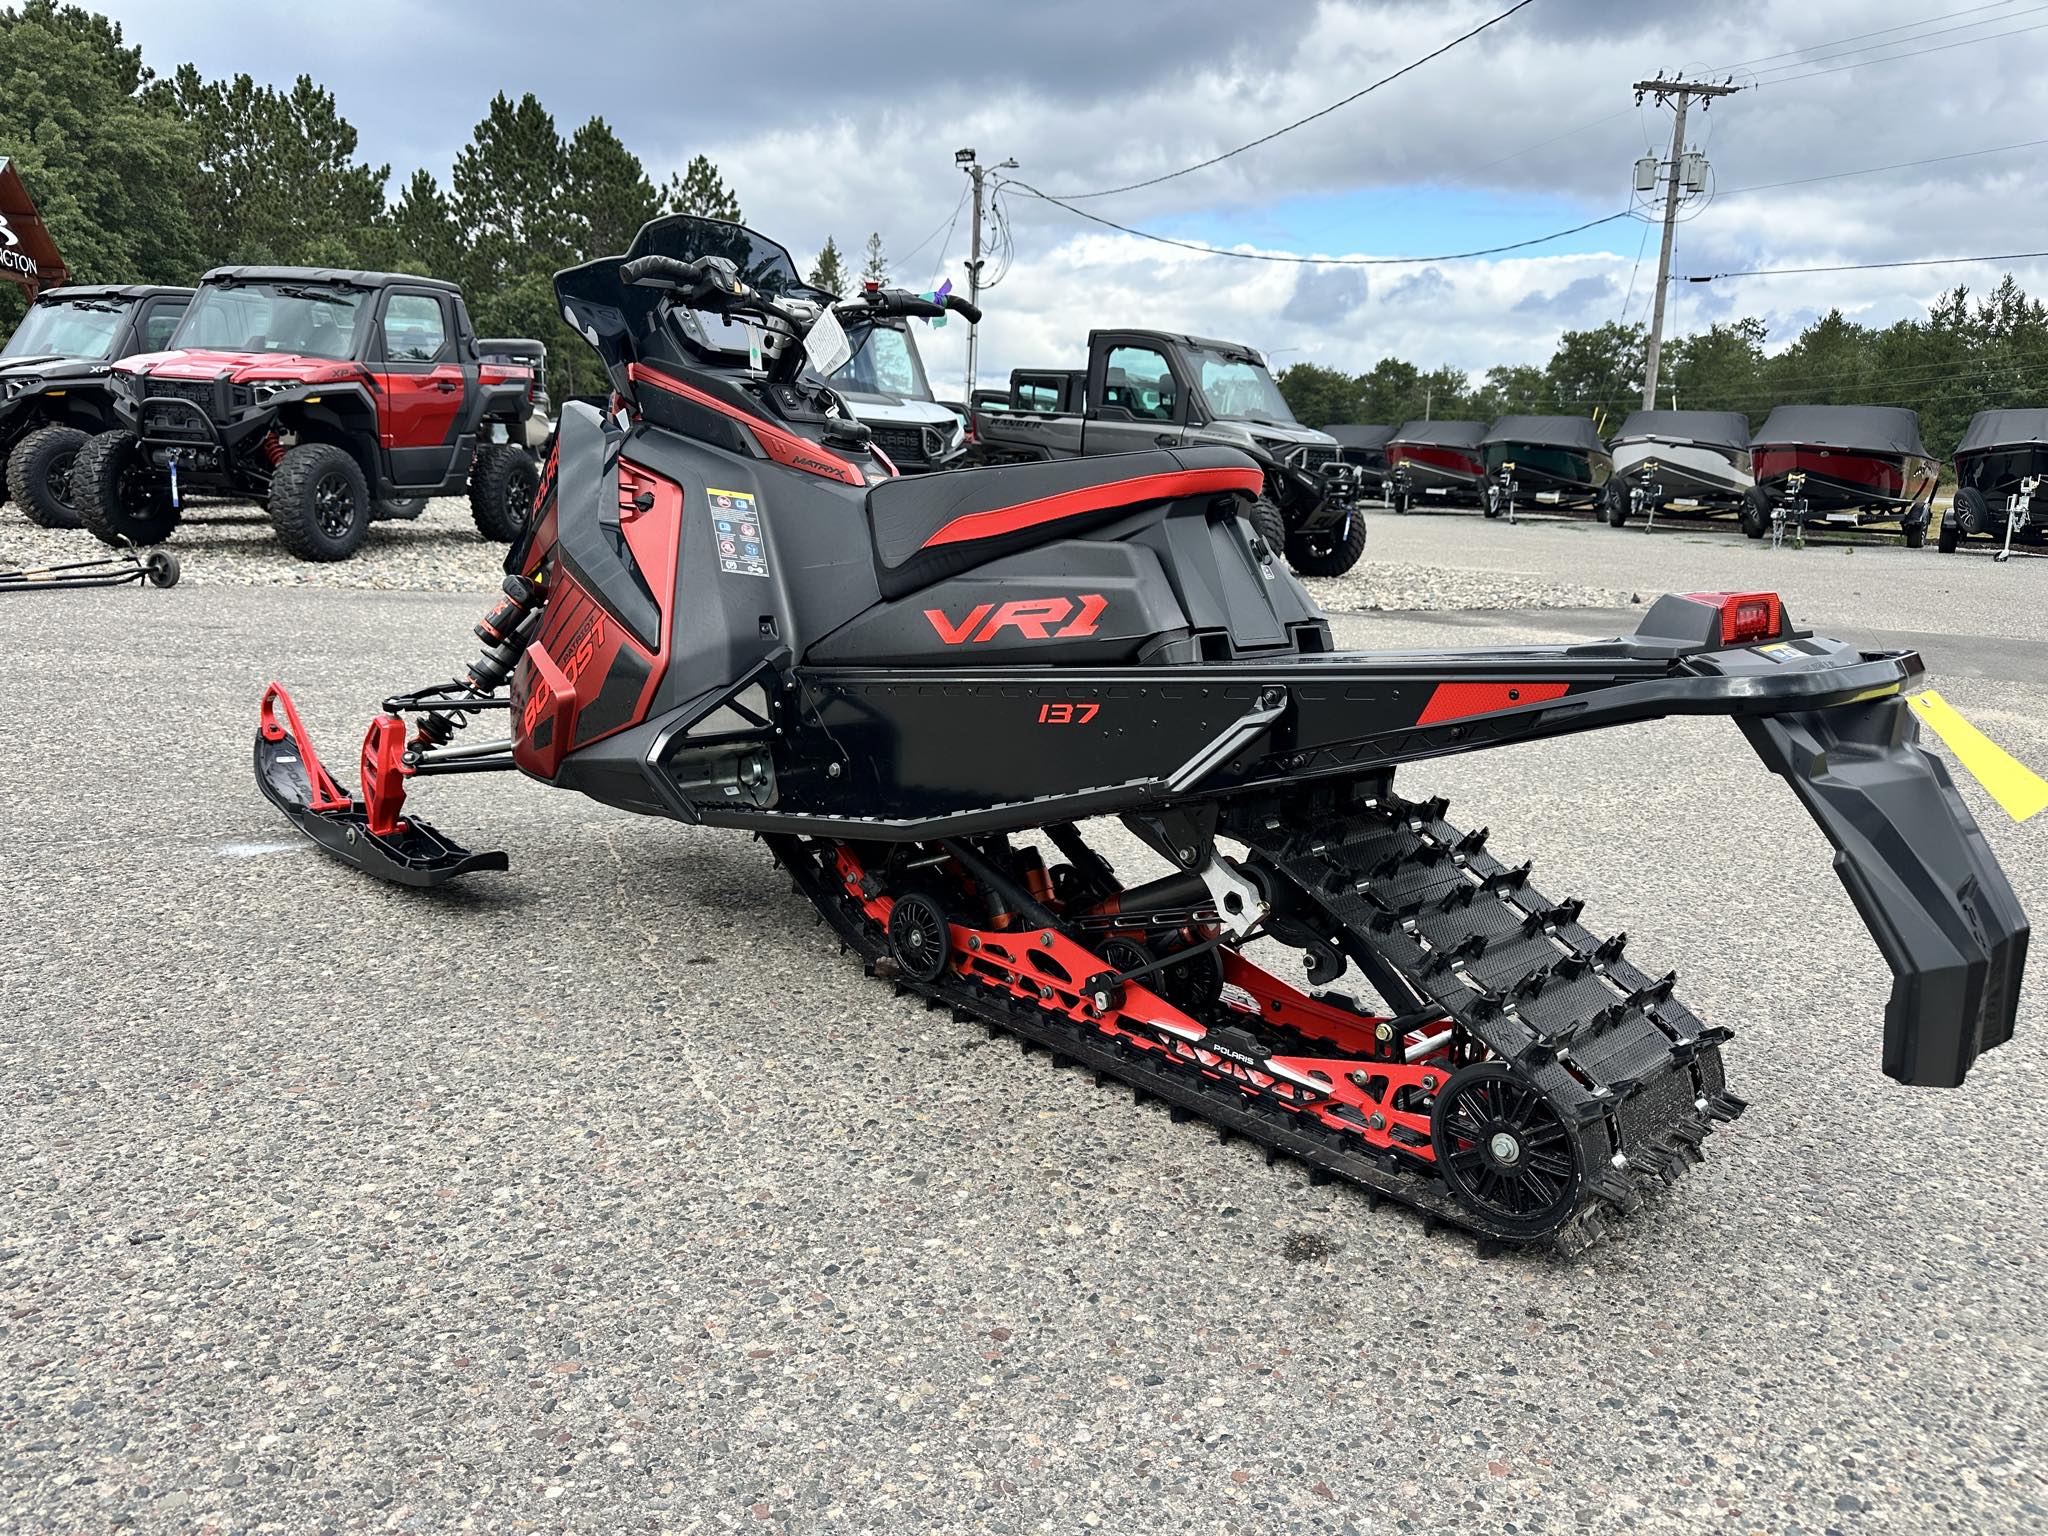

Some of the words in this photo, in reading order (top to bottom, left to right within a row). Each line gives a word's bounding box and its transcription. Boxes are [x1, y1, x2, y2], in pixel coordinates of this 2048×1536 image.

[0, 247, 37, 274] GTON
[991, 419, 1042, 429] RANGER
[871, 434, 919, 448] OLARIS
[792, 455, 846, 480] MATRYX
[923, 594, 1109, 644] VR1
[562, 615, 595, 664] PATRIOT
[524, 610, 608, 738] BOOST
[1038, 703, 1100, 724] 137
[1213, 1043, 1255, 1066] POLARIS
